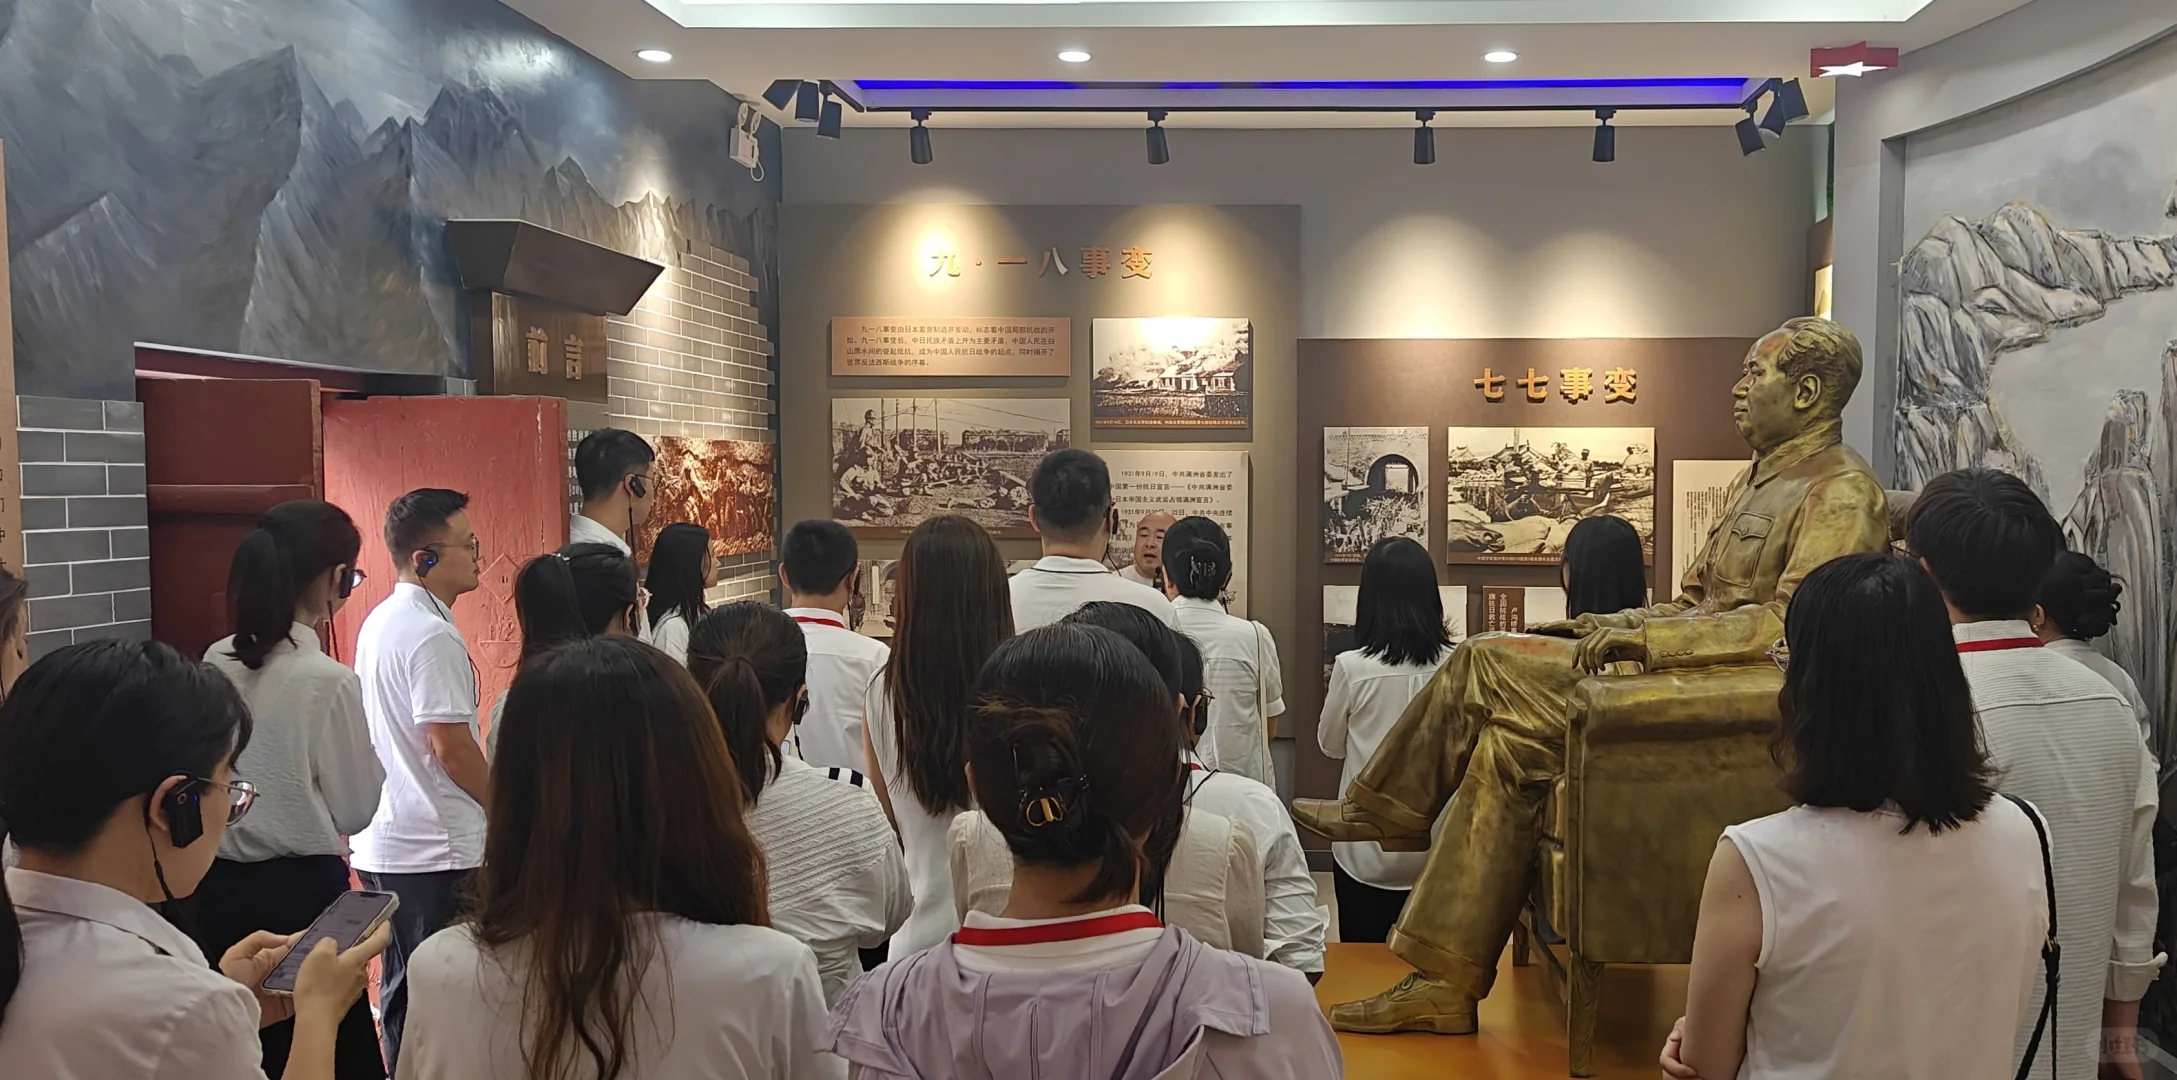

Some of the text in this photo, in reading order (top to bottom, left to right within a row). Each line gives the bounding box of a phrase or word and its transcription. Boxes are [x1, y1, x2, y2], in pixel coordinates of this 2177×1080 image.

[525, 326, 584, 380] 前言
[1473, 366, 1637, 405] 七七事变
[1112, 496, 1220, 504] 日本帝国主义武装占领满洲宣言》。
[1499, 593, 1507, 632] 全国抗战的
